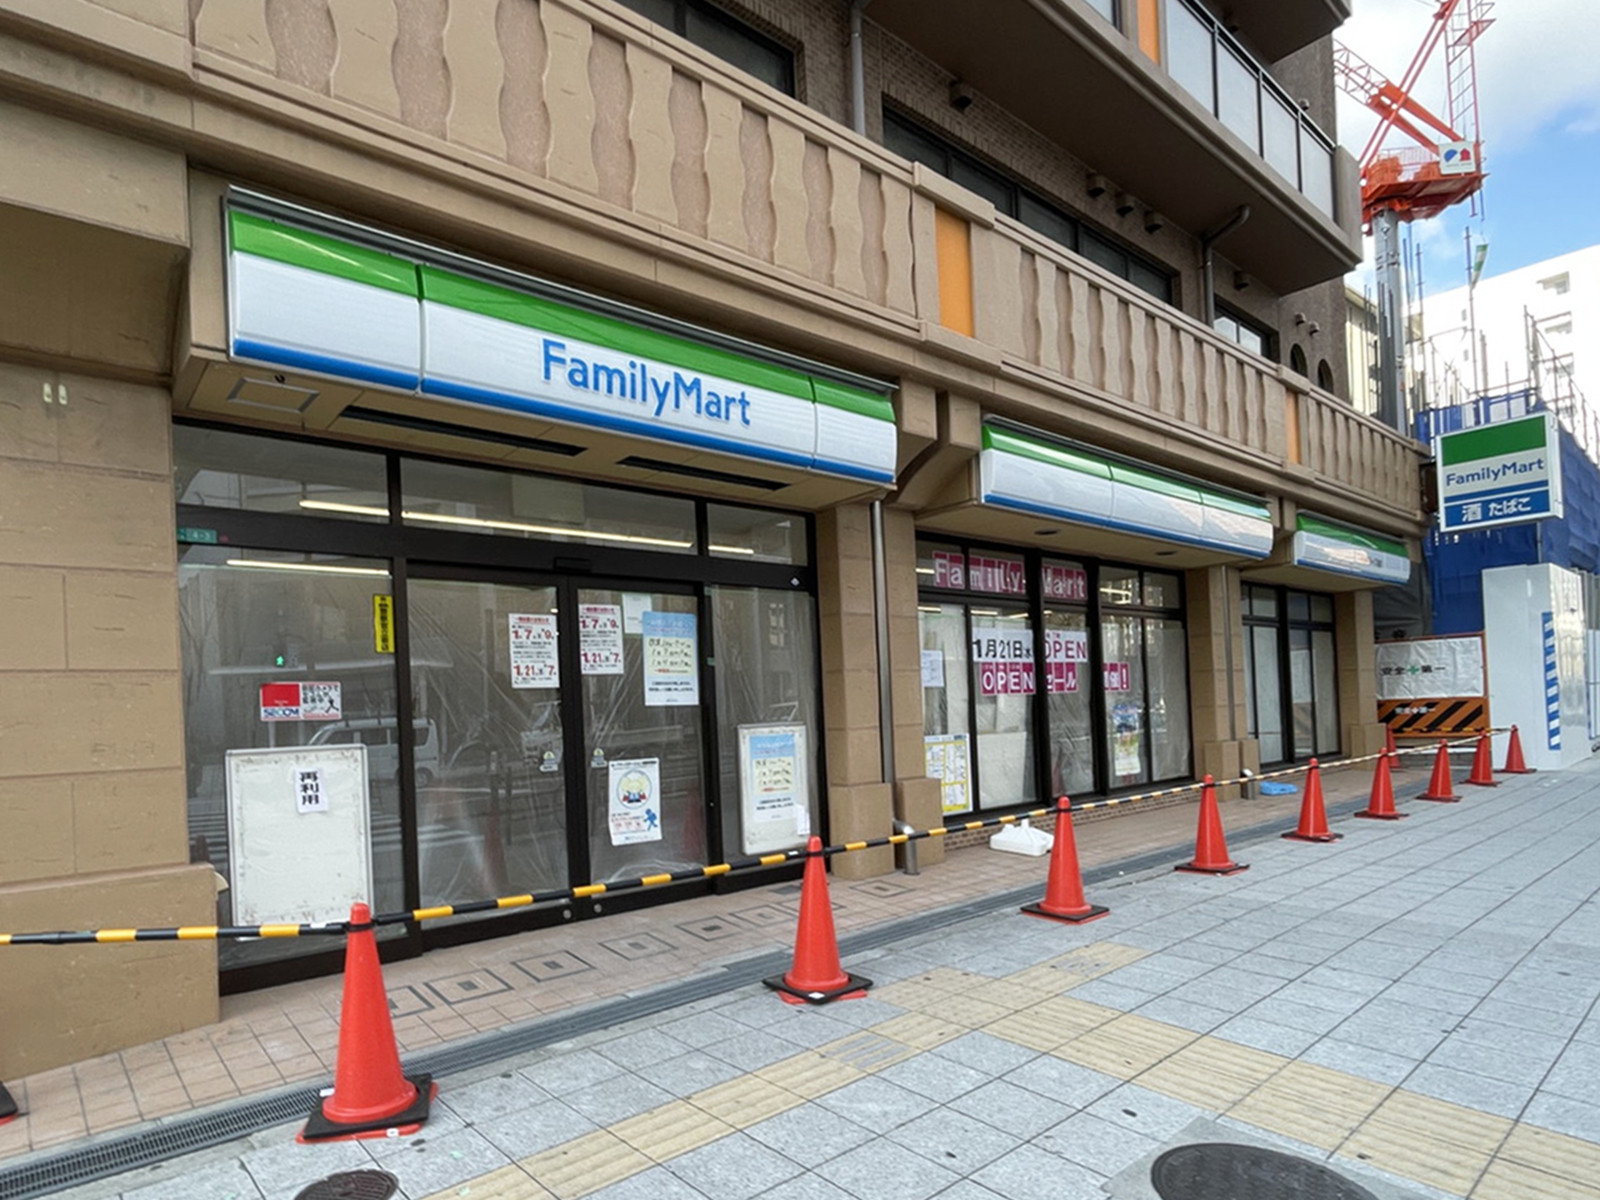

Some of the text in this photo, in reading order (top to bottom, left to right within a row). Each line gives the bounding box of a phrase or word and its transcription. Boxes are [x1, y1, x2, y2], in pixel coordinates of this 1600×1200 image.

[542, 338, 751, 426] FamilyMart
[1446, 458, 1545, 486] FamilyMart
[1462, 497, 1531, 522] 酒 たばこ
[935, 558, 1021, 592] Family
[983, 672, 1034, 690] OPEN
